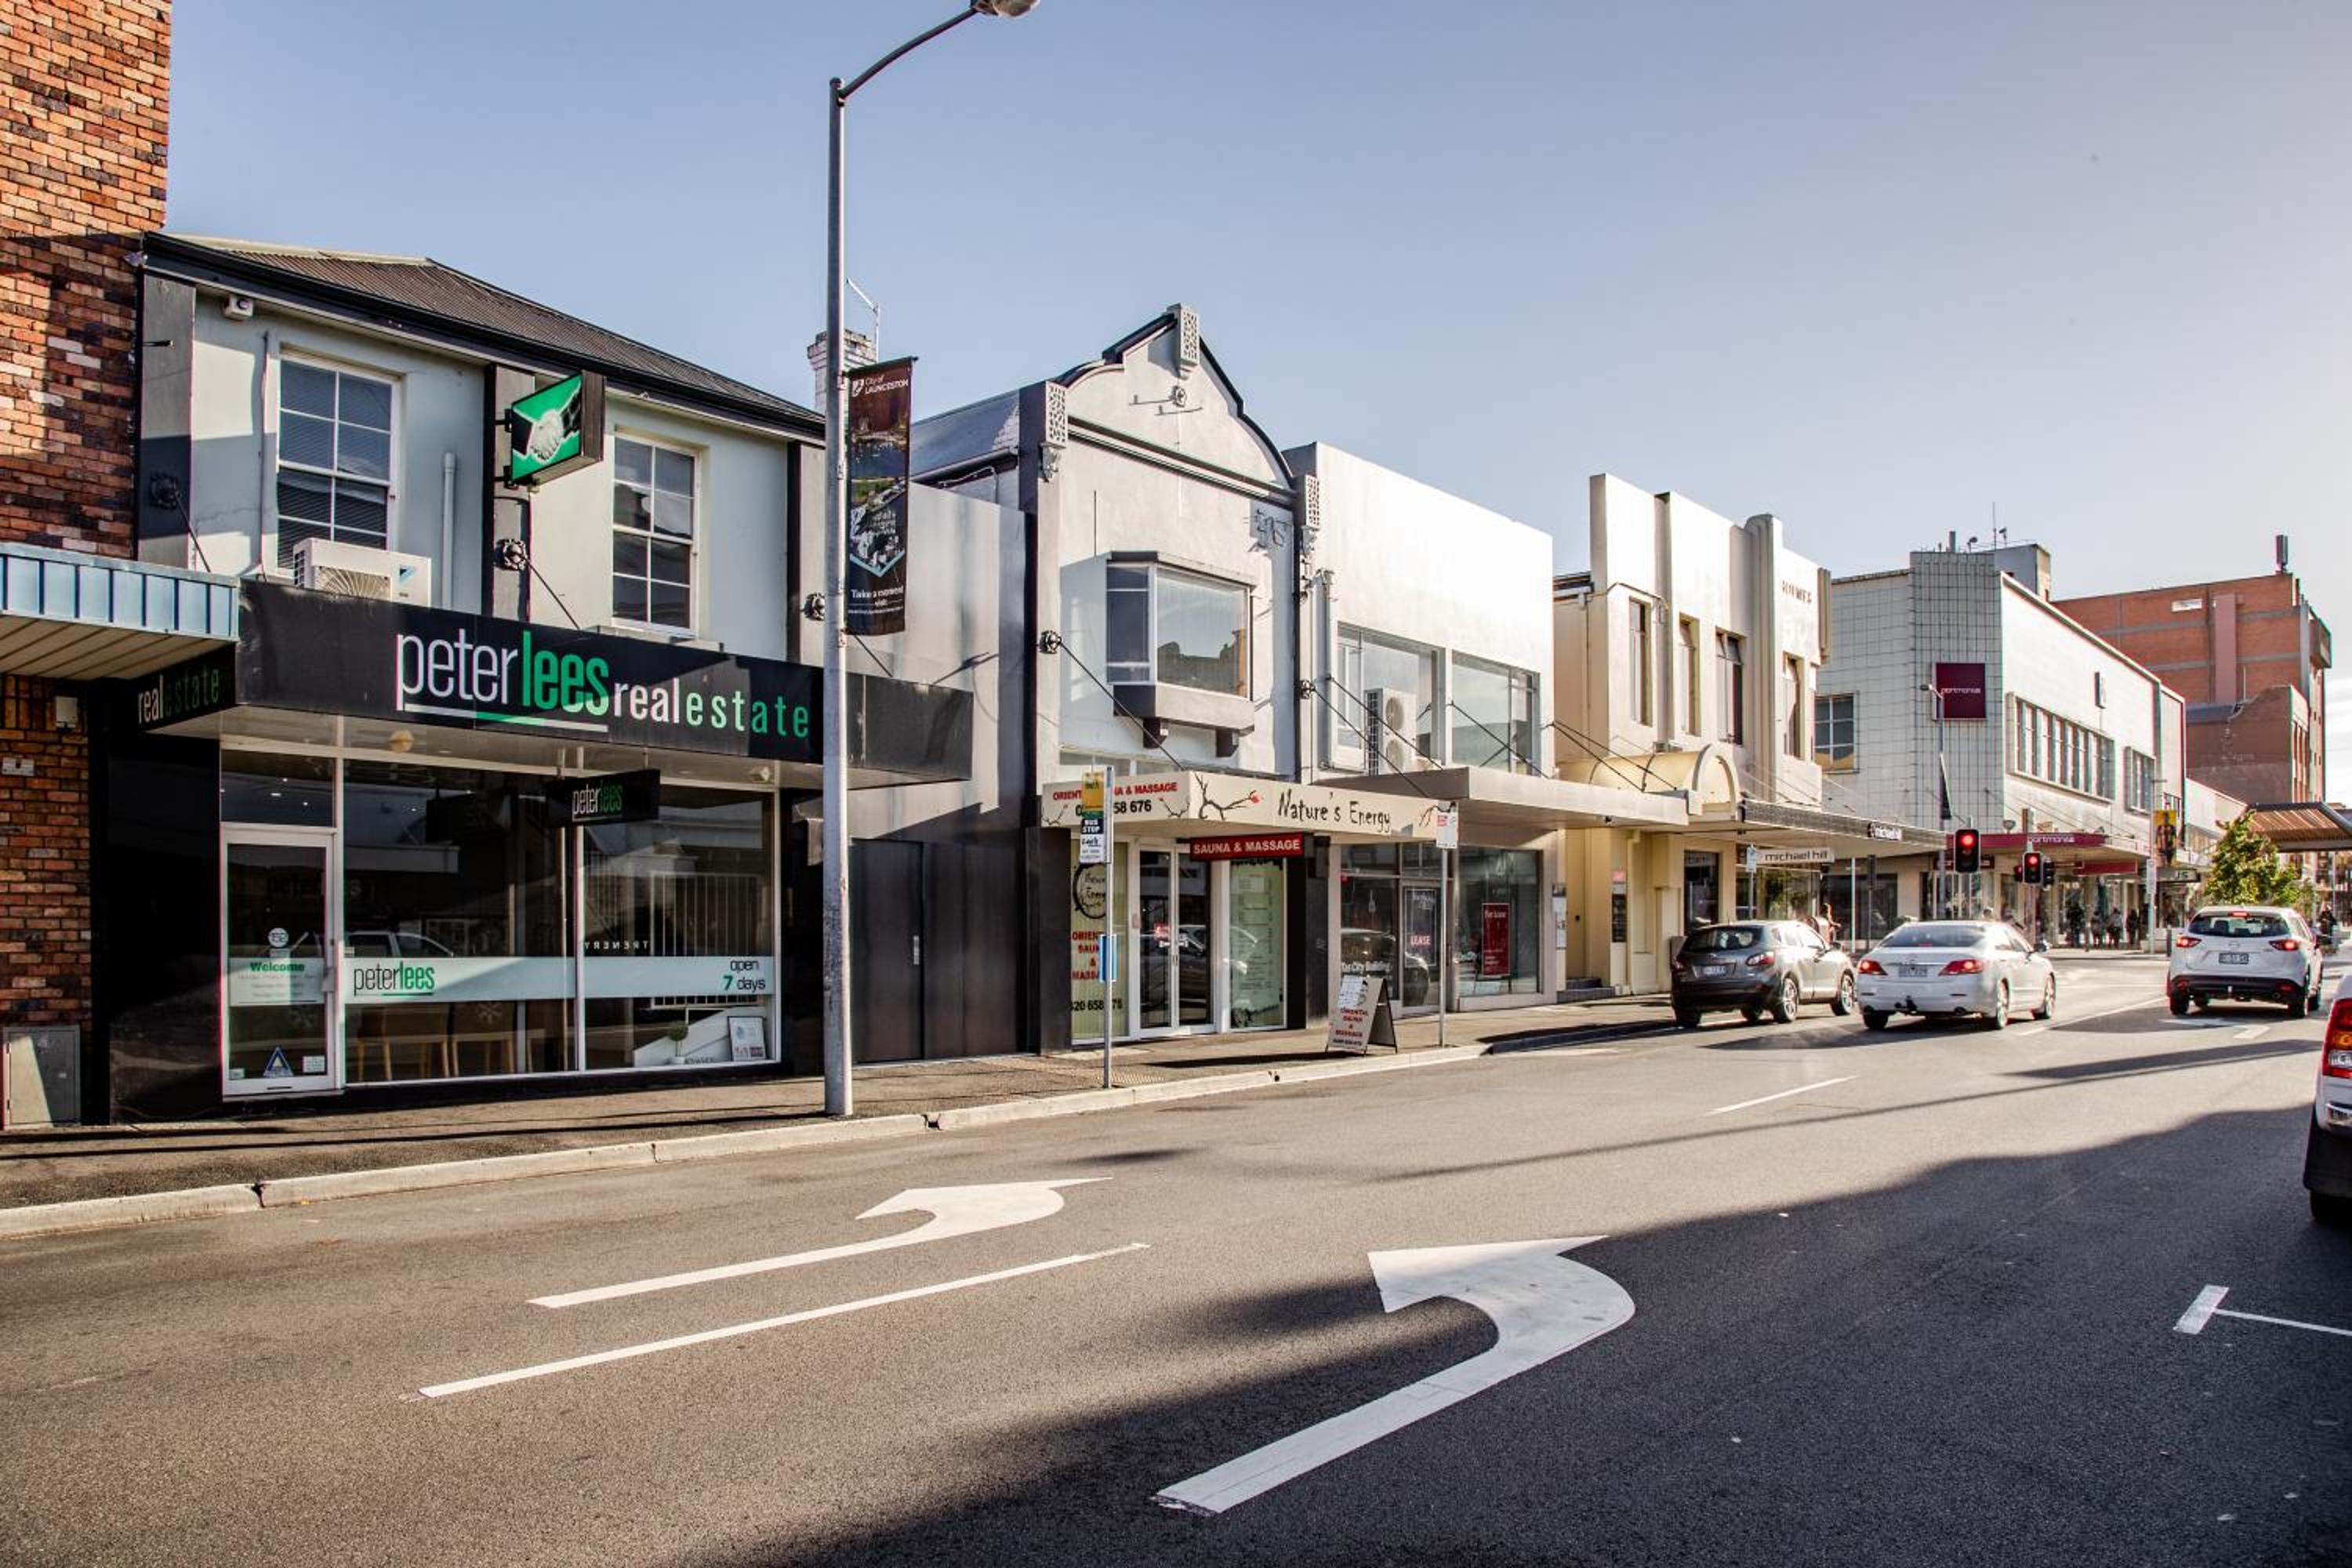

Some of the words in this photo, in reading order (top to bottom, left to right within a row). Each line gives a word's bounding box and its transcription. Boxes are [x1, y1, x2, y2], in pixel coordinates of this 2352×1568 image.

[851, 590, 872, 599] Take
[1053, 790, 1082, 800] ORIENT
[1134, 782, 1178, 794] MASSAGE
[1113, 802, 1127, 814] 58
[1130, 800, 1152, 813] 676
[1278, 788, 1341, 822] Nature's
[1349, 800, 1391, 833] Energy
[1193, 844, 1230, 855] SAUNA
[1233, 844, 1243, 852] &
[1244, 839, 1301, 851] MASSAGE
[1765, 851, 1810, 862] michael
[1812, 850, 1828, 860] hill
[1072, 931, 1103, 941] ORIEN
[1078, 944, 1100, 954] SAU
[250, 961, 305, 972] Welcome
[730, 960, 760, 974] open
[354, 960, 435, 996] peterlees
[1072, 970, 1100, 980] MASS
[723, 975, 734, 990] 7
[737, 976, 766, 993] days
